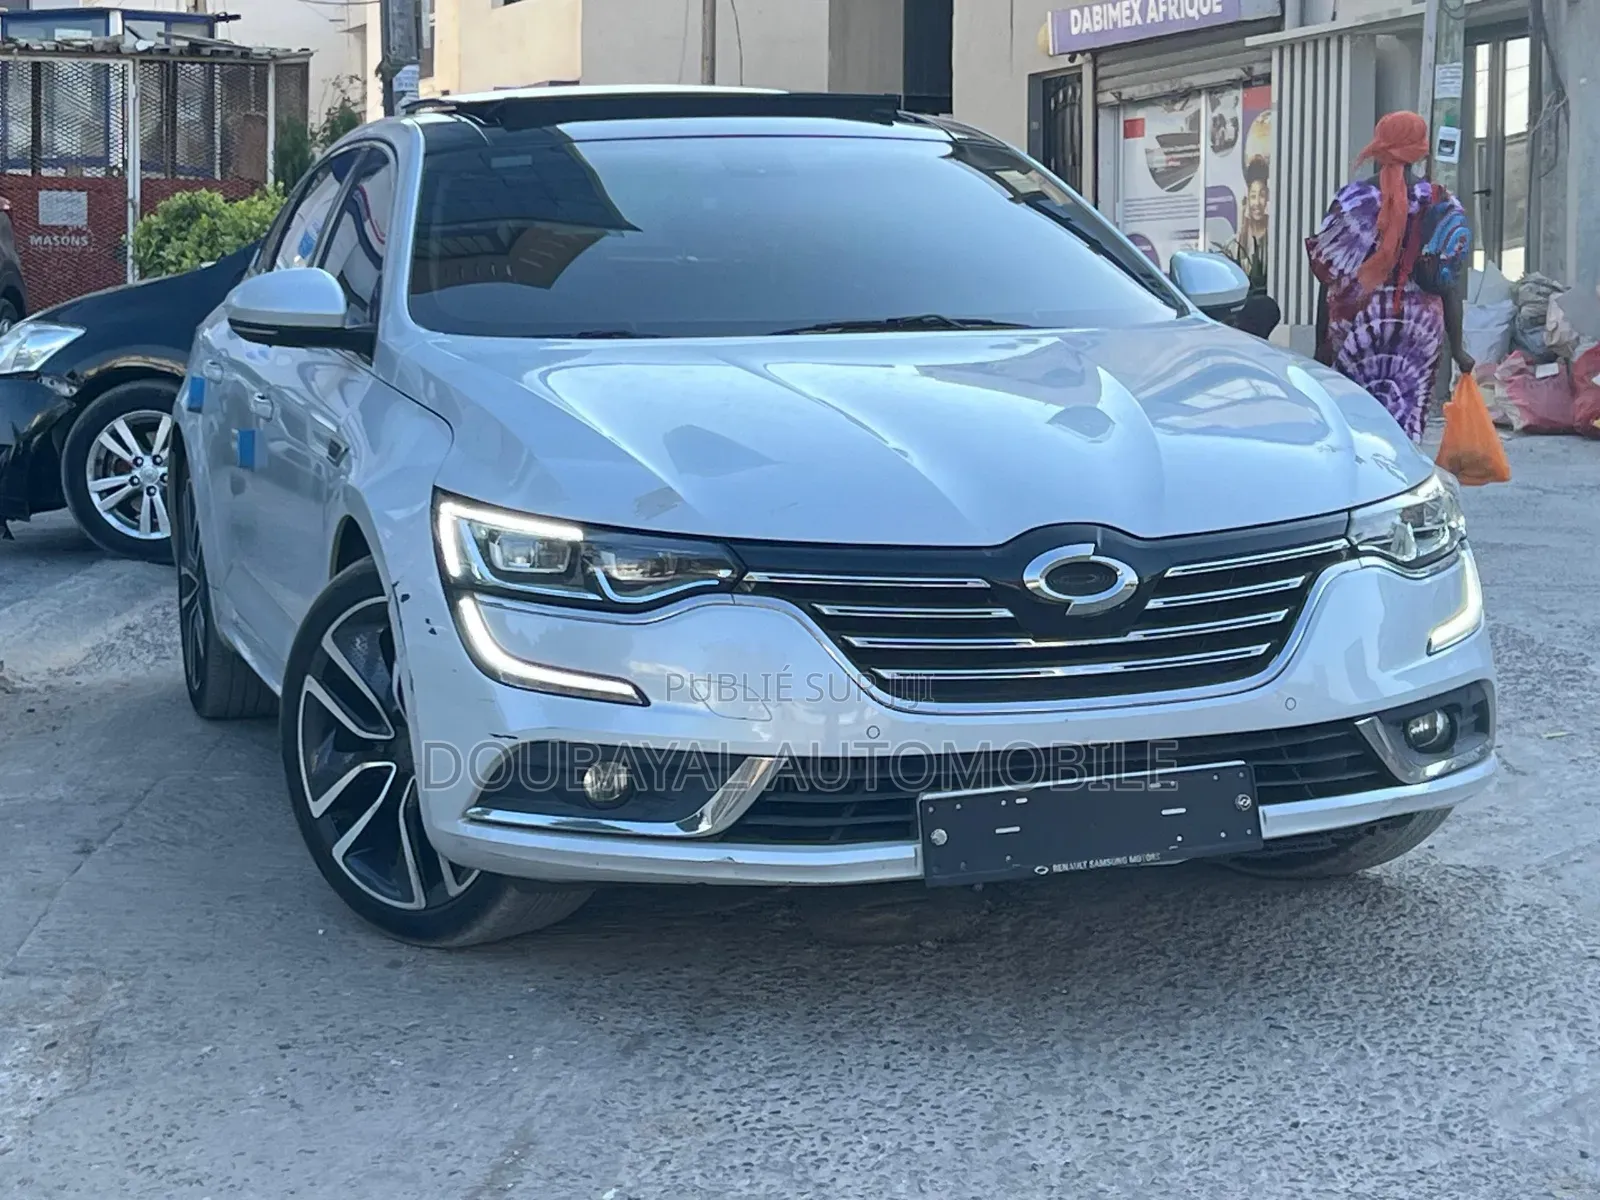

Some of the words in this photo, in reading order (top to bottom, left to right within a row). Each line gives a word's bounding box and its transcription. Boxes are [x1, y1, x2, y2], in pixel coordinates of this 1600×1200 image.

[1070, 0, 1142, 35] DABIMEX
[1146, 0, 1223, 23] AFRIQUE
[28, 235, 89, 246] MASONS
[1052, 860, 1088, 873] RENAULT
[1089, 856, 1128, 869] SAMSUNG
[1129, 852, 1161, 863] MOTORS
